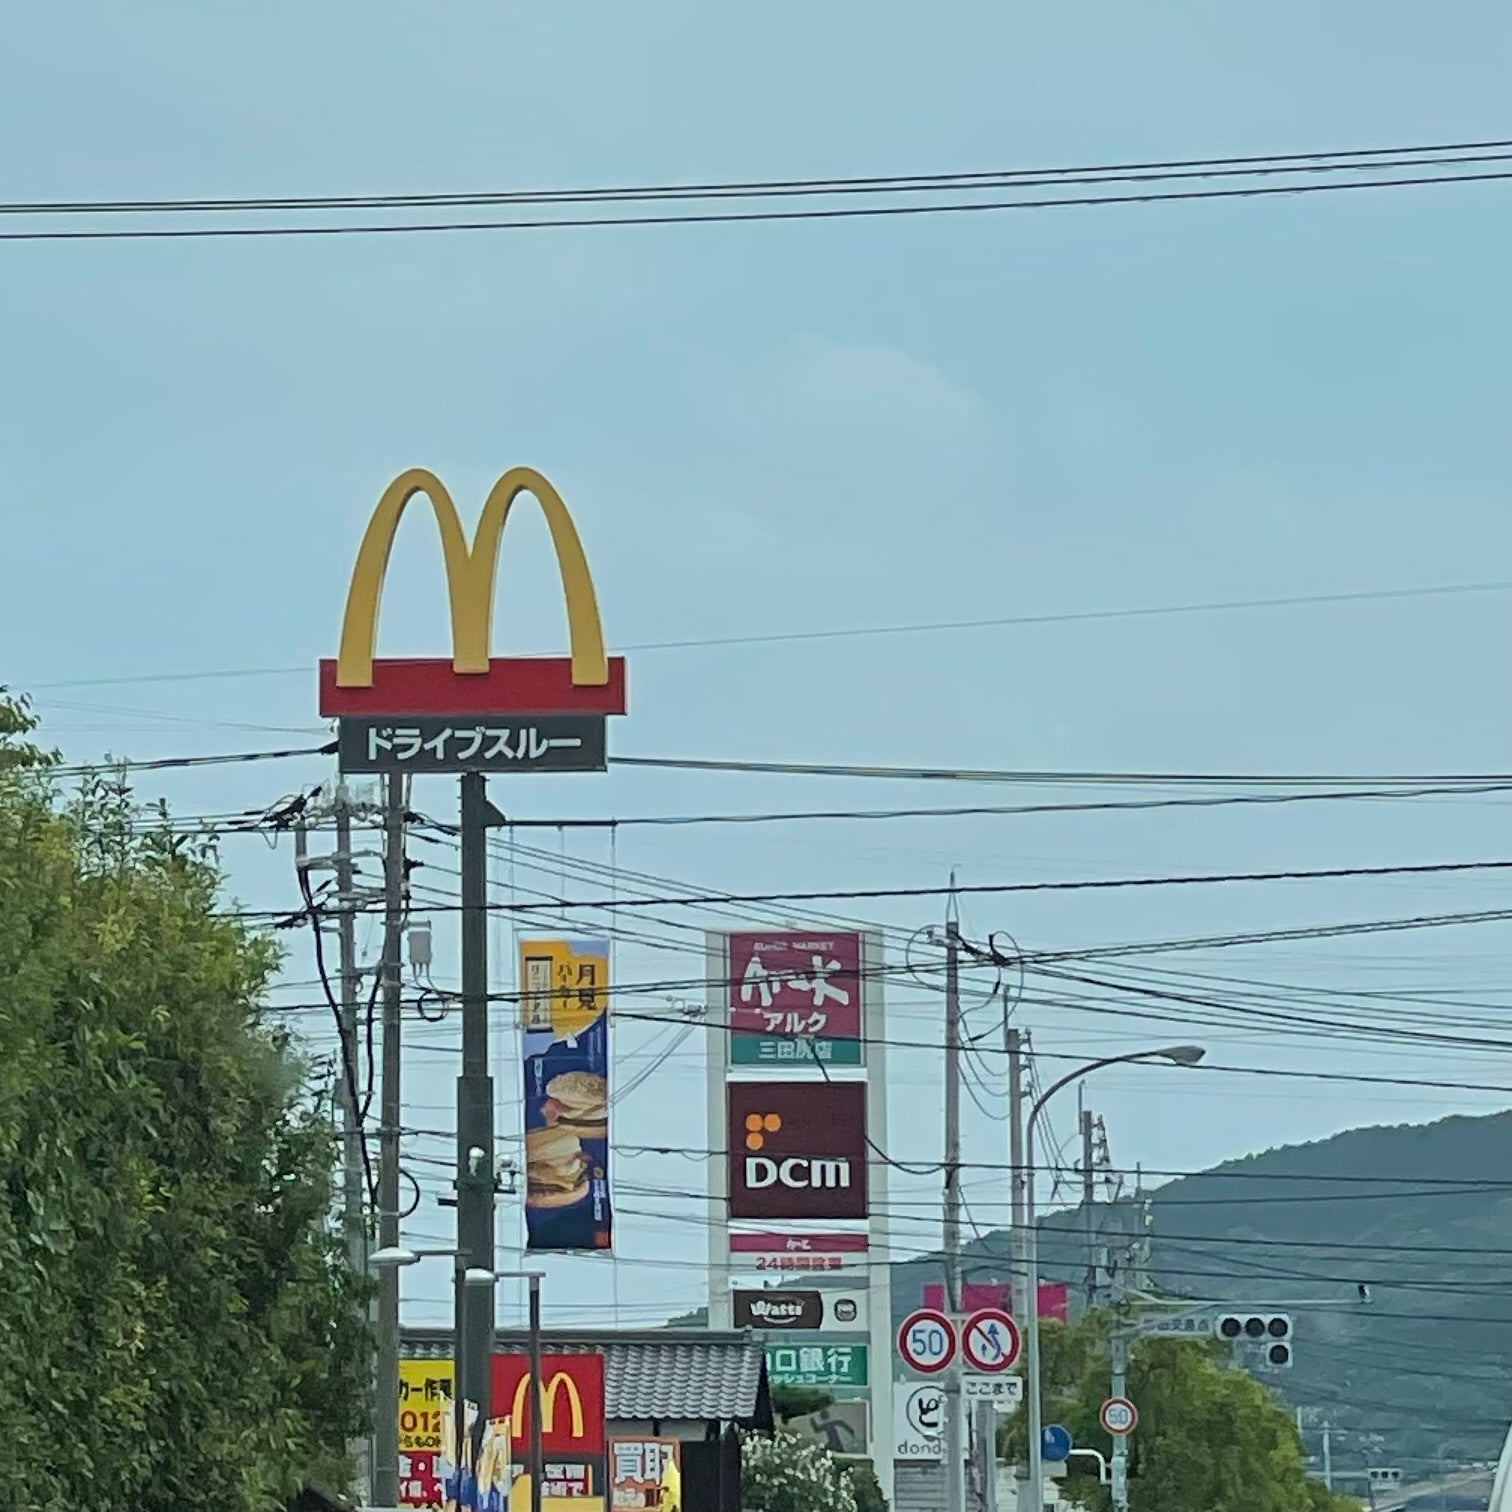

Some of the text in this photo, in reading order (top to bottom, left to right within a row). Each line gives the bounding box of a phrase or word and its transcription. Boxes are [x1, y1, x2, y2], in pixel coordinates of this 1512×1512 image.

[367, 725, 582, 761] ドライブスルー
[762, 1011, 827, 1033] アルク
[911, 1329, 945, 1357] 50
[965, 1381, 1018, 1396] ここまで
[1107, 1409, 1130, 1426] 50
